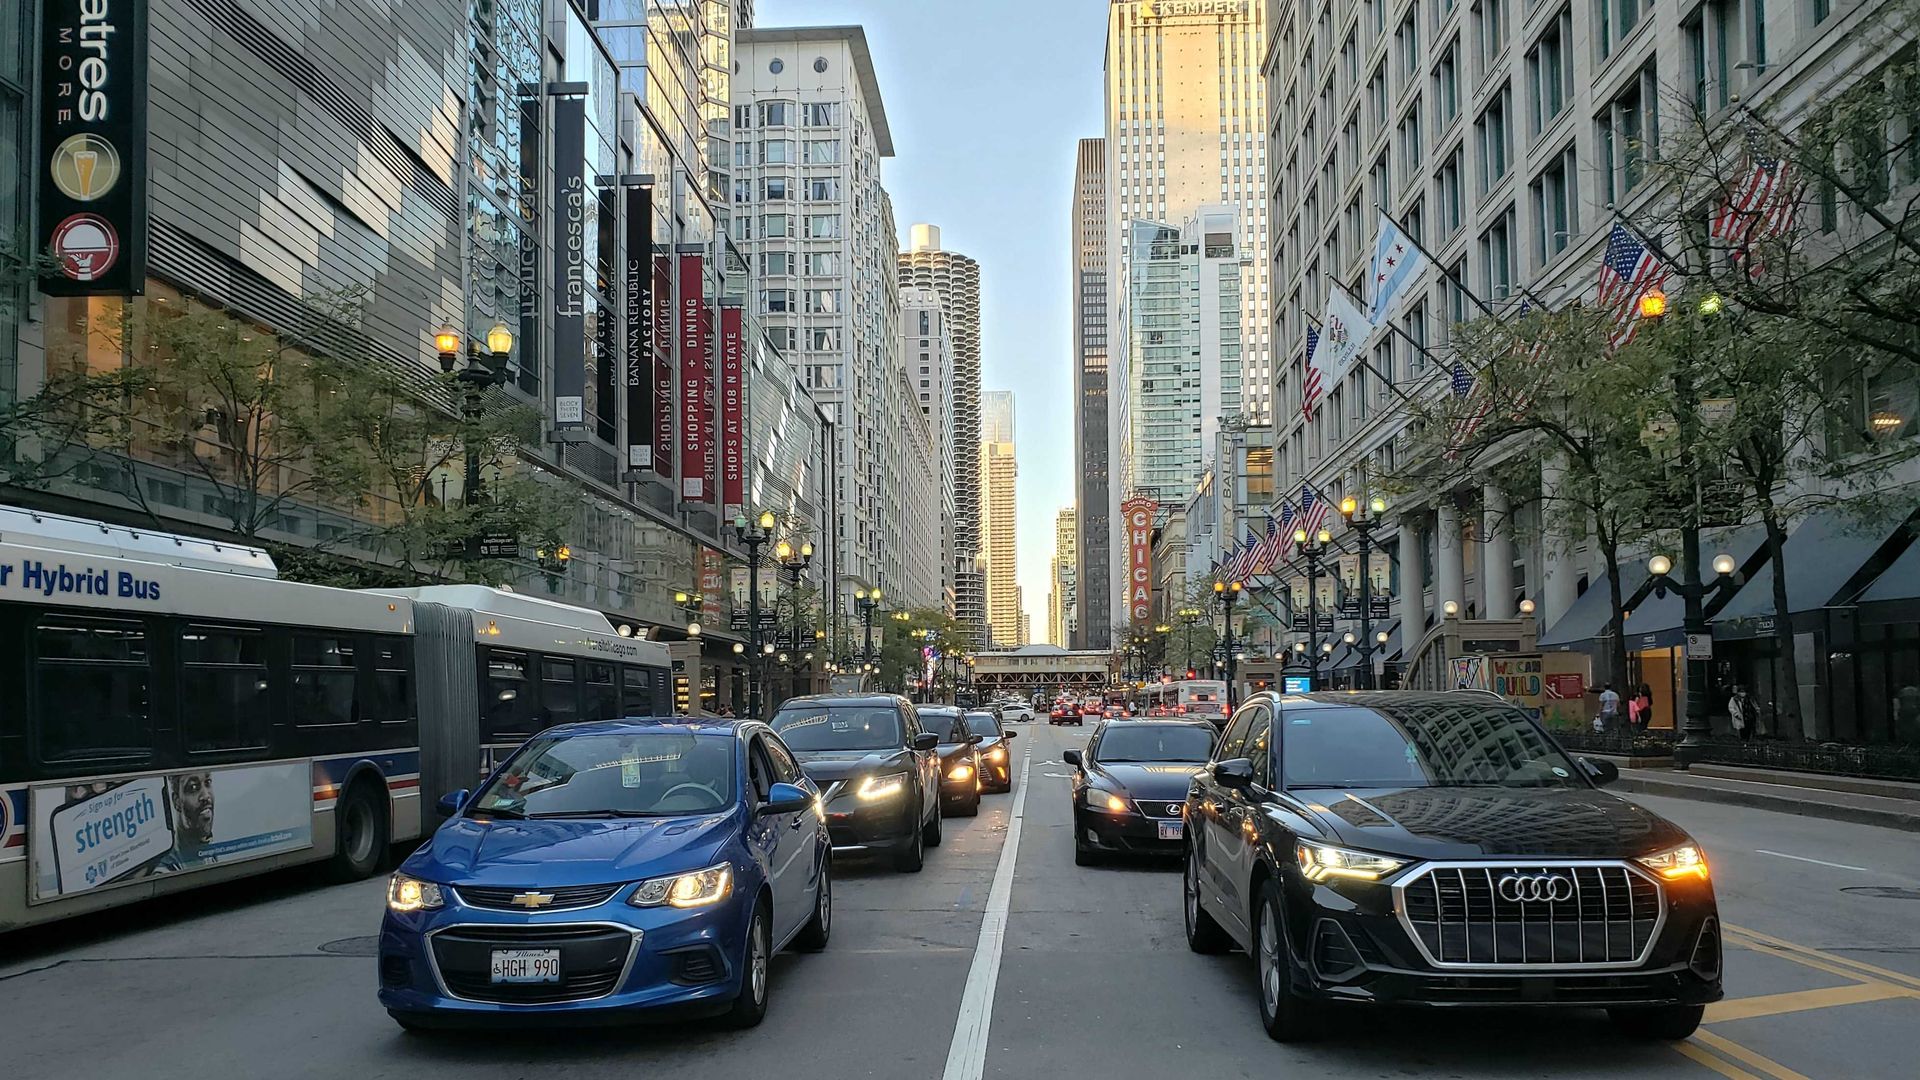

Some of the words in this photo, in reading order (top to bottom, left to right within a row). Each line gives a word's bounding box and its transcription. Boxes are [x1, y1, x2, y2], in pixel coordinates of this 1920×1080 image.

[1159, 0, 1241, 16] KEMPER
[79, 0, 116, 122] atres
[556, 176, 582, 318] francesca's
[628, 259, 639, 325] REPUBLIC
[643, 289, 652, 357] FACTORY
[687, 299, 697, 348] DINING
[629, 328, 640, 386] BANANA
[727, 332, 737, 370] STATE
[727, 376, 736, 384] N
[728, 390, 737, 412] 108
[687, 380, 698, 450] SHOPPING
[728, 421, 737, 433] AT
[728, 440, 737, 480] SHOPS
[1223, 433, 1232, 499] BALLET
[23, 559, 109, 597] Hybrid
[118, 571, 161, 601] Bus
[1496, 675, 1540, 696] BUILD
[75, 792, 155, 853] strength
[88, 802, 103, 813] Sign
[104, 797, 113, 807] up
[114, 792, 124, 806] for
[502, 959, 527, 977] HGH
[534, 959, 558, 977] 990
